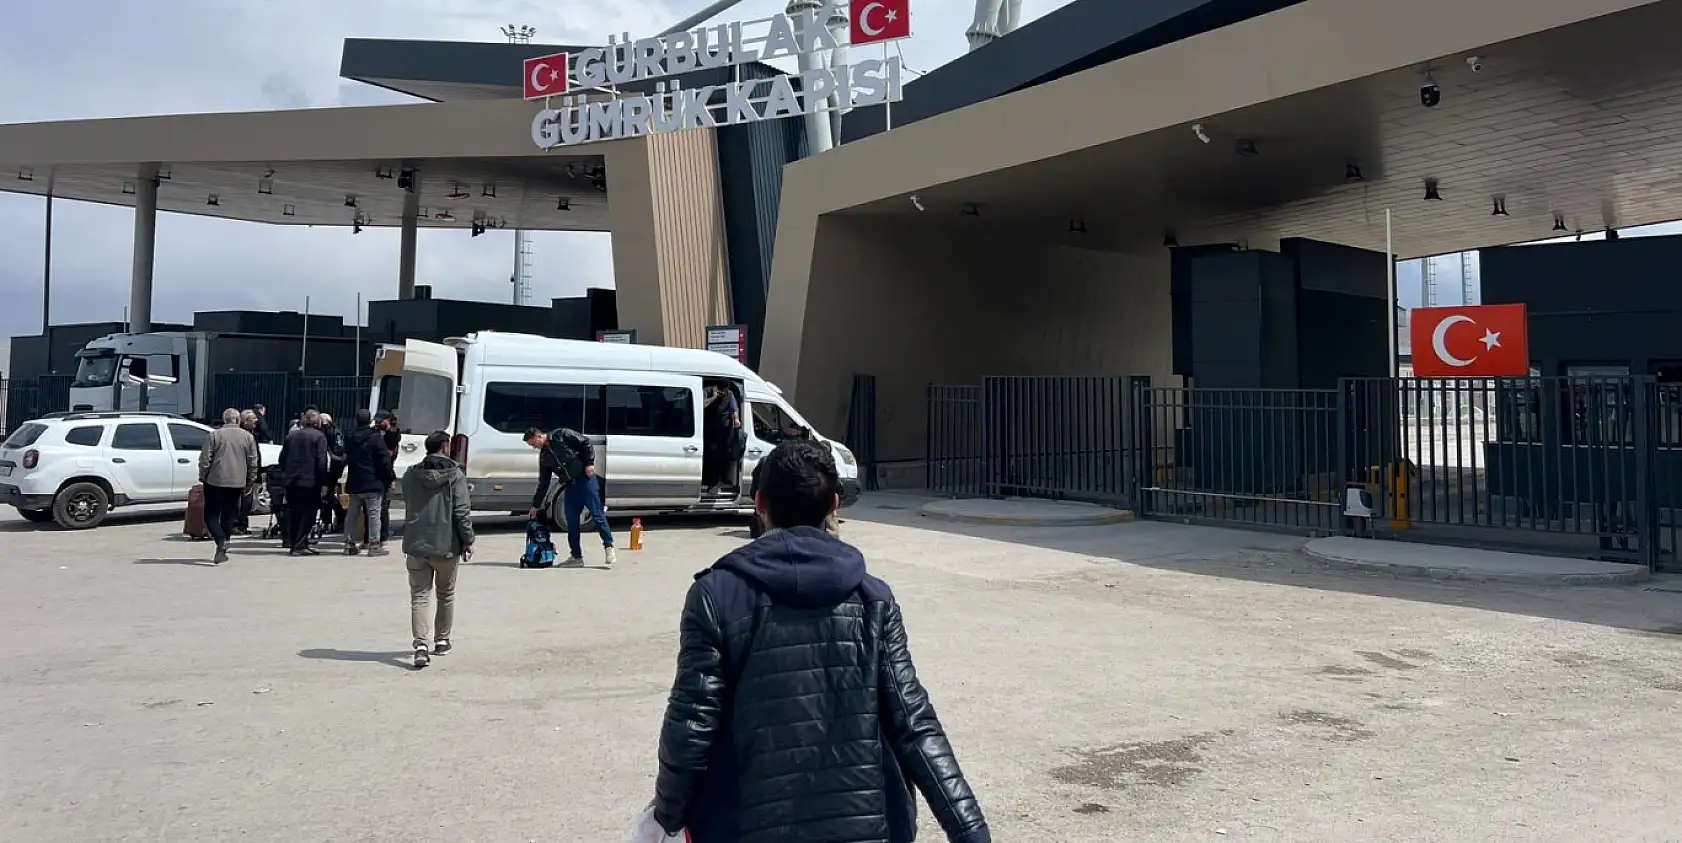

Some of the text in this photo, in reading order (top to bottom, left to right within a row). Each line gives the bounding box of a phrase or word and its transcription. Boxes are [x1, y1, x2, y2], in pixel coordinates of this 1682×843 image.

[575, 8, 838, 88] GÜRBULAK
[531, 57, 902, 148] GÜMRÜK KAPISI
